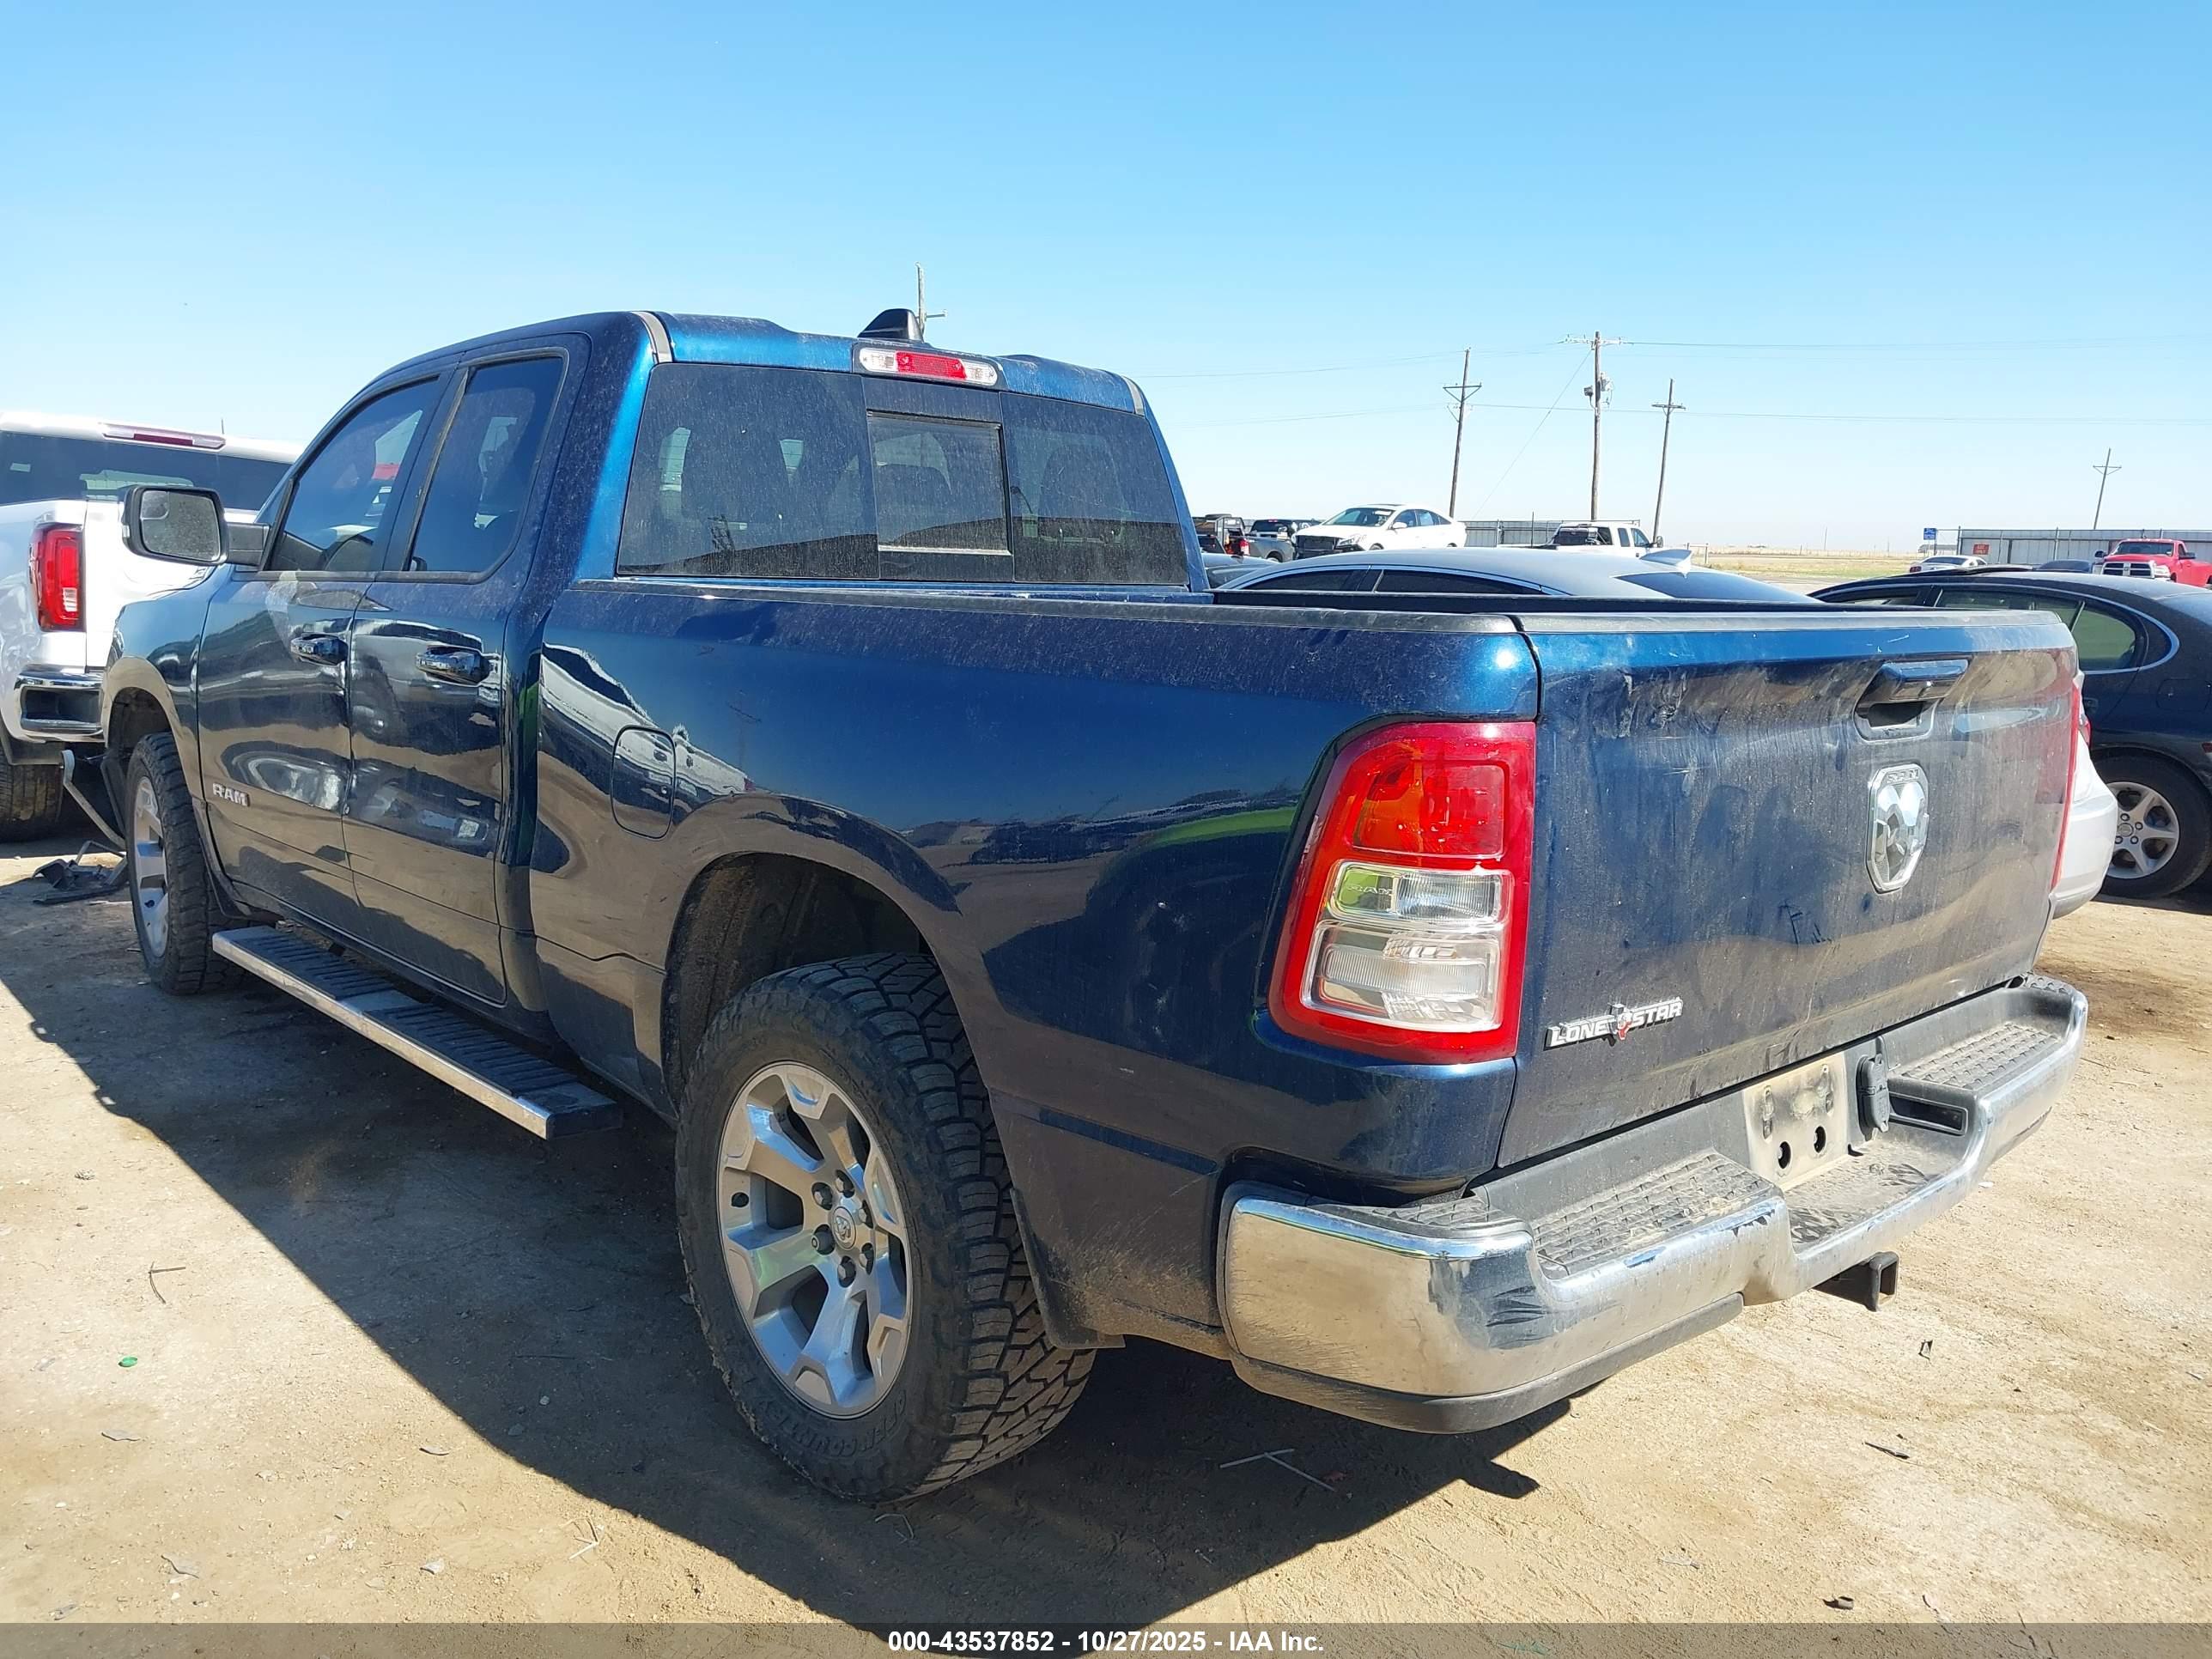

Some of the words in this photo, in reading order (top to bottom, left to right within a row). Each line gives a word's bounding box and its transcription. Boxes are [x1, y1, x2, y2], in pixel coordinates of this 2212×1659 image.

[212, 782, 249, 806] RAM
[1547, 1014, 1615, 1048] LONE
[1628, 999, 1684, 1030] STAR
